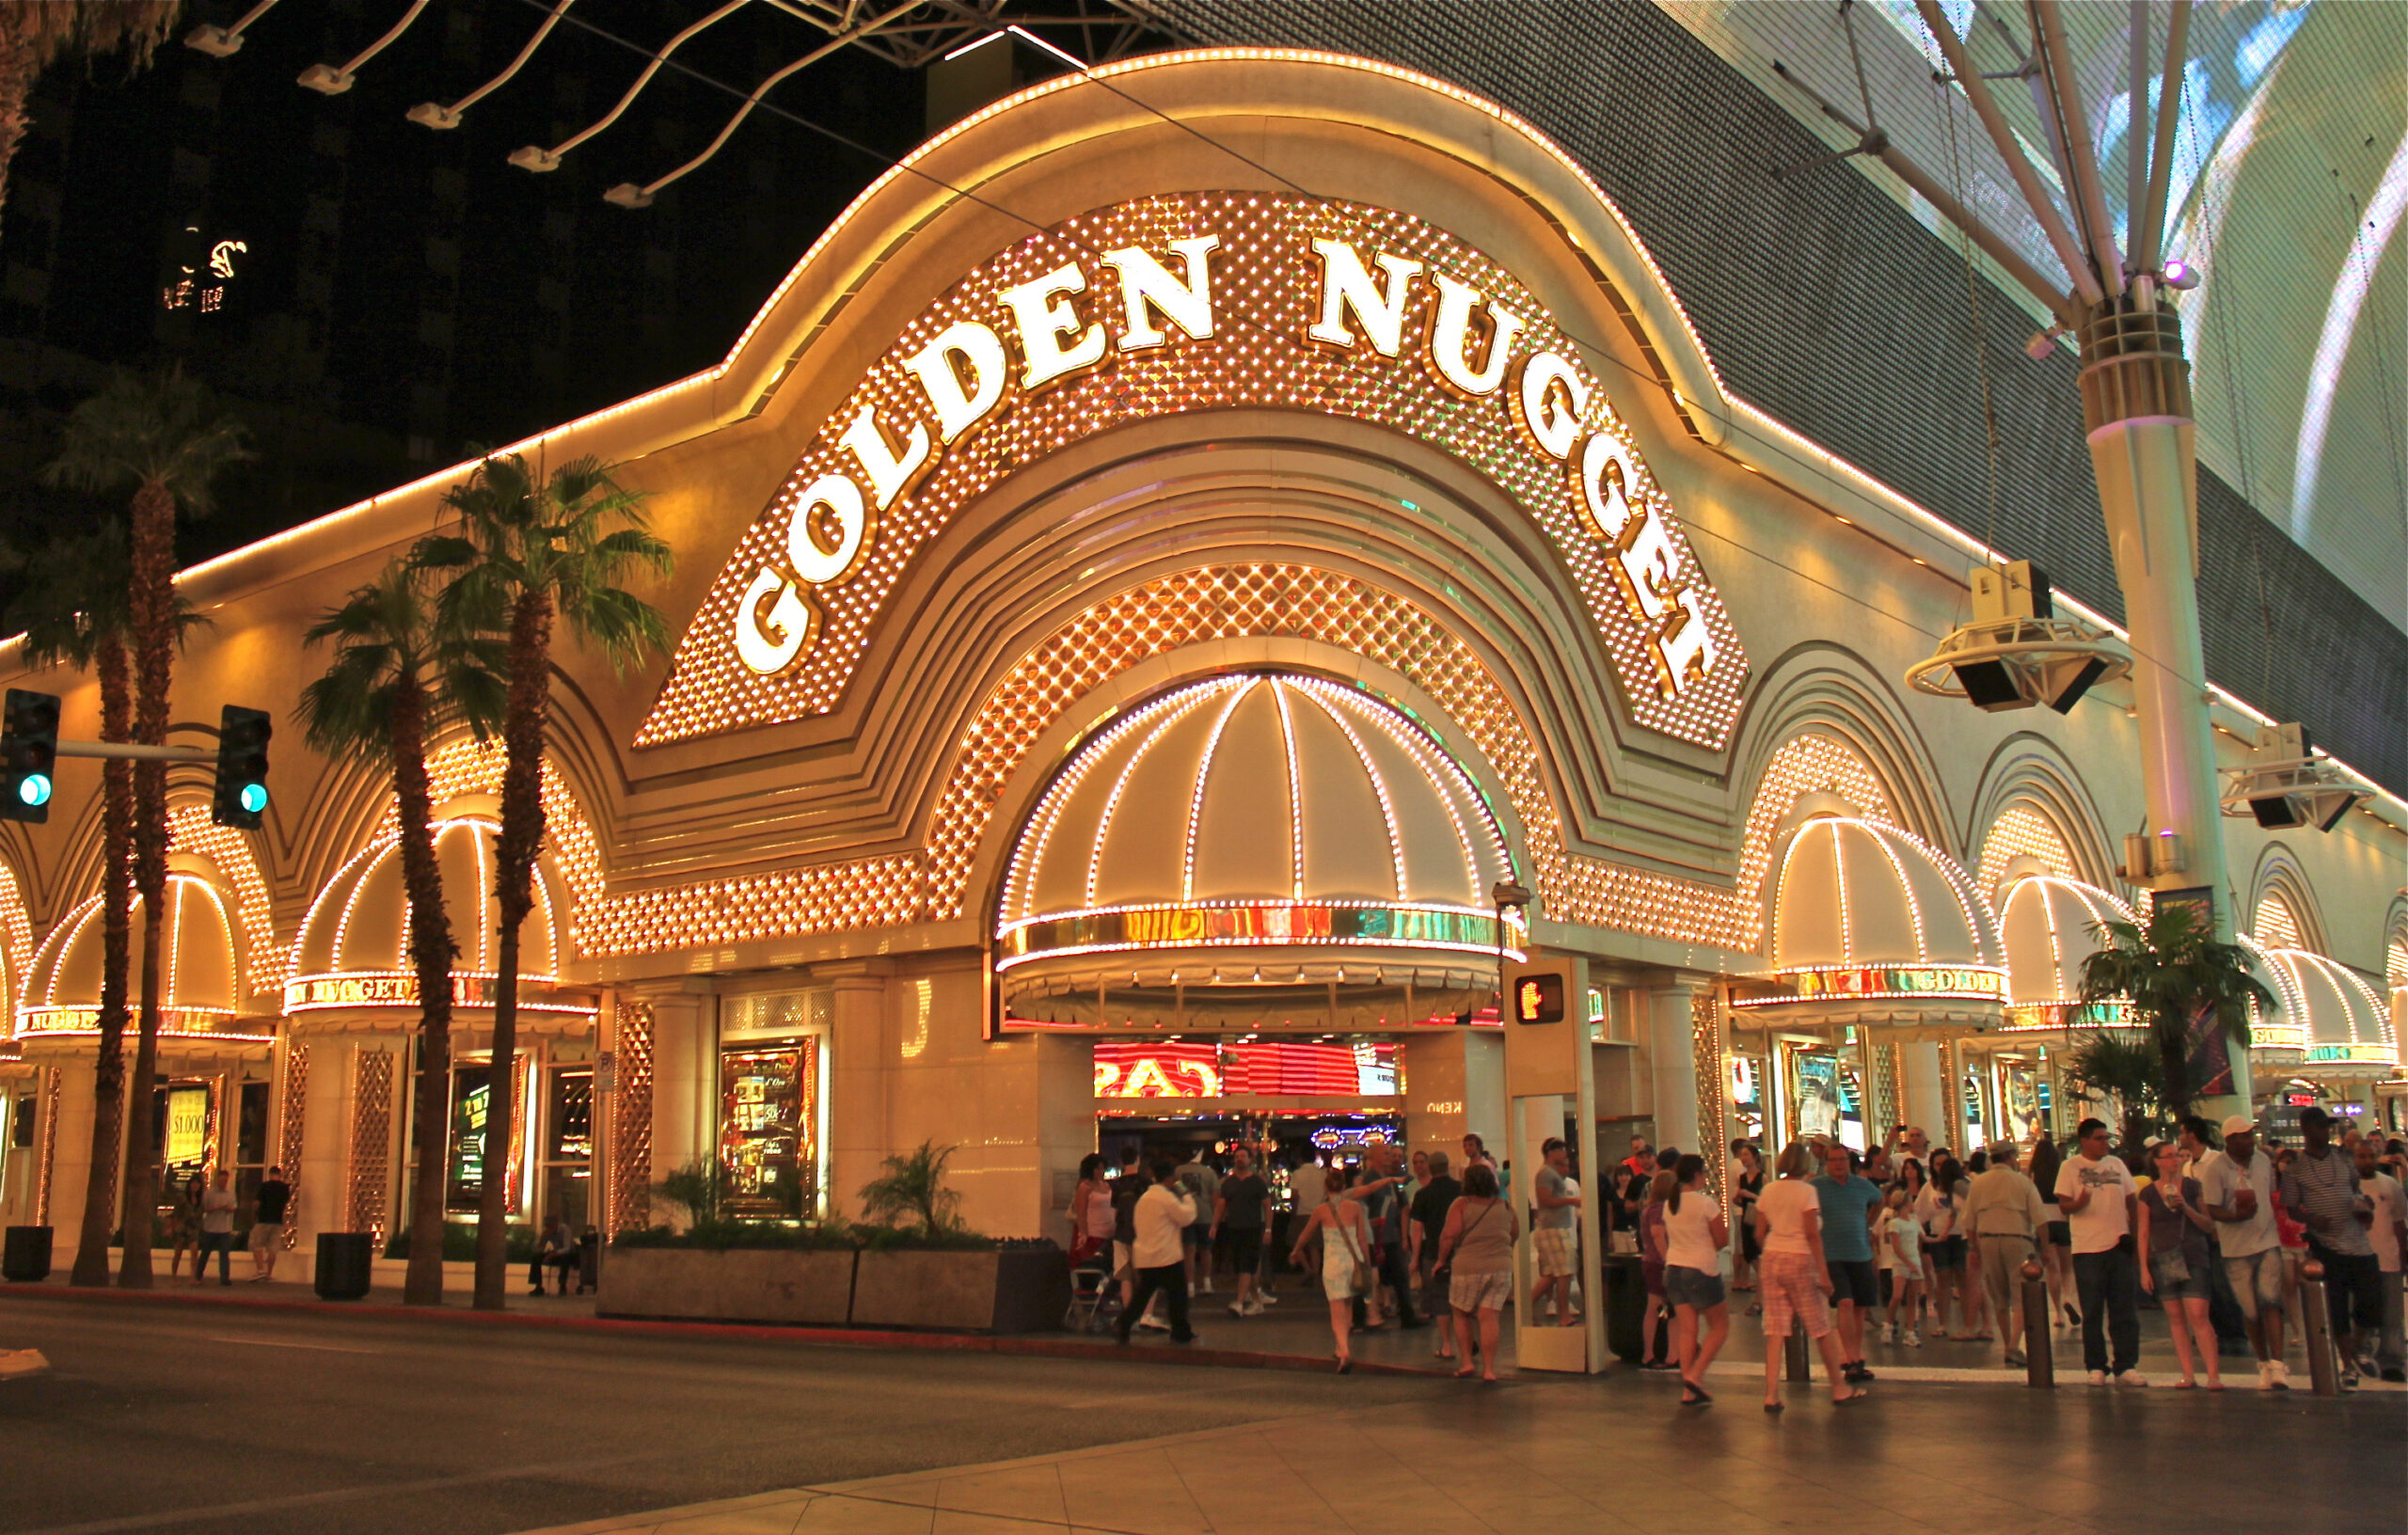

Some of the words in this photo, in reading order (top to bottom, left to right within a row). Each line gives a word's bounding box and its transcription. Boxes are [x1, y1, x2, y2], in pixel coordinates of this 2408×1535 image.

[735, 233, 1220, 675] GOLDEN
[1307, 237, 1716, 697] NUGGET
[311, 978, 408, 1004] NUGGET
